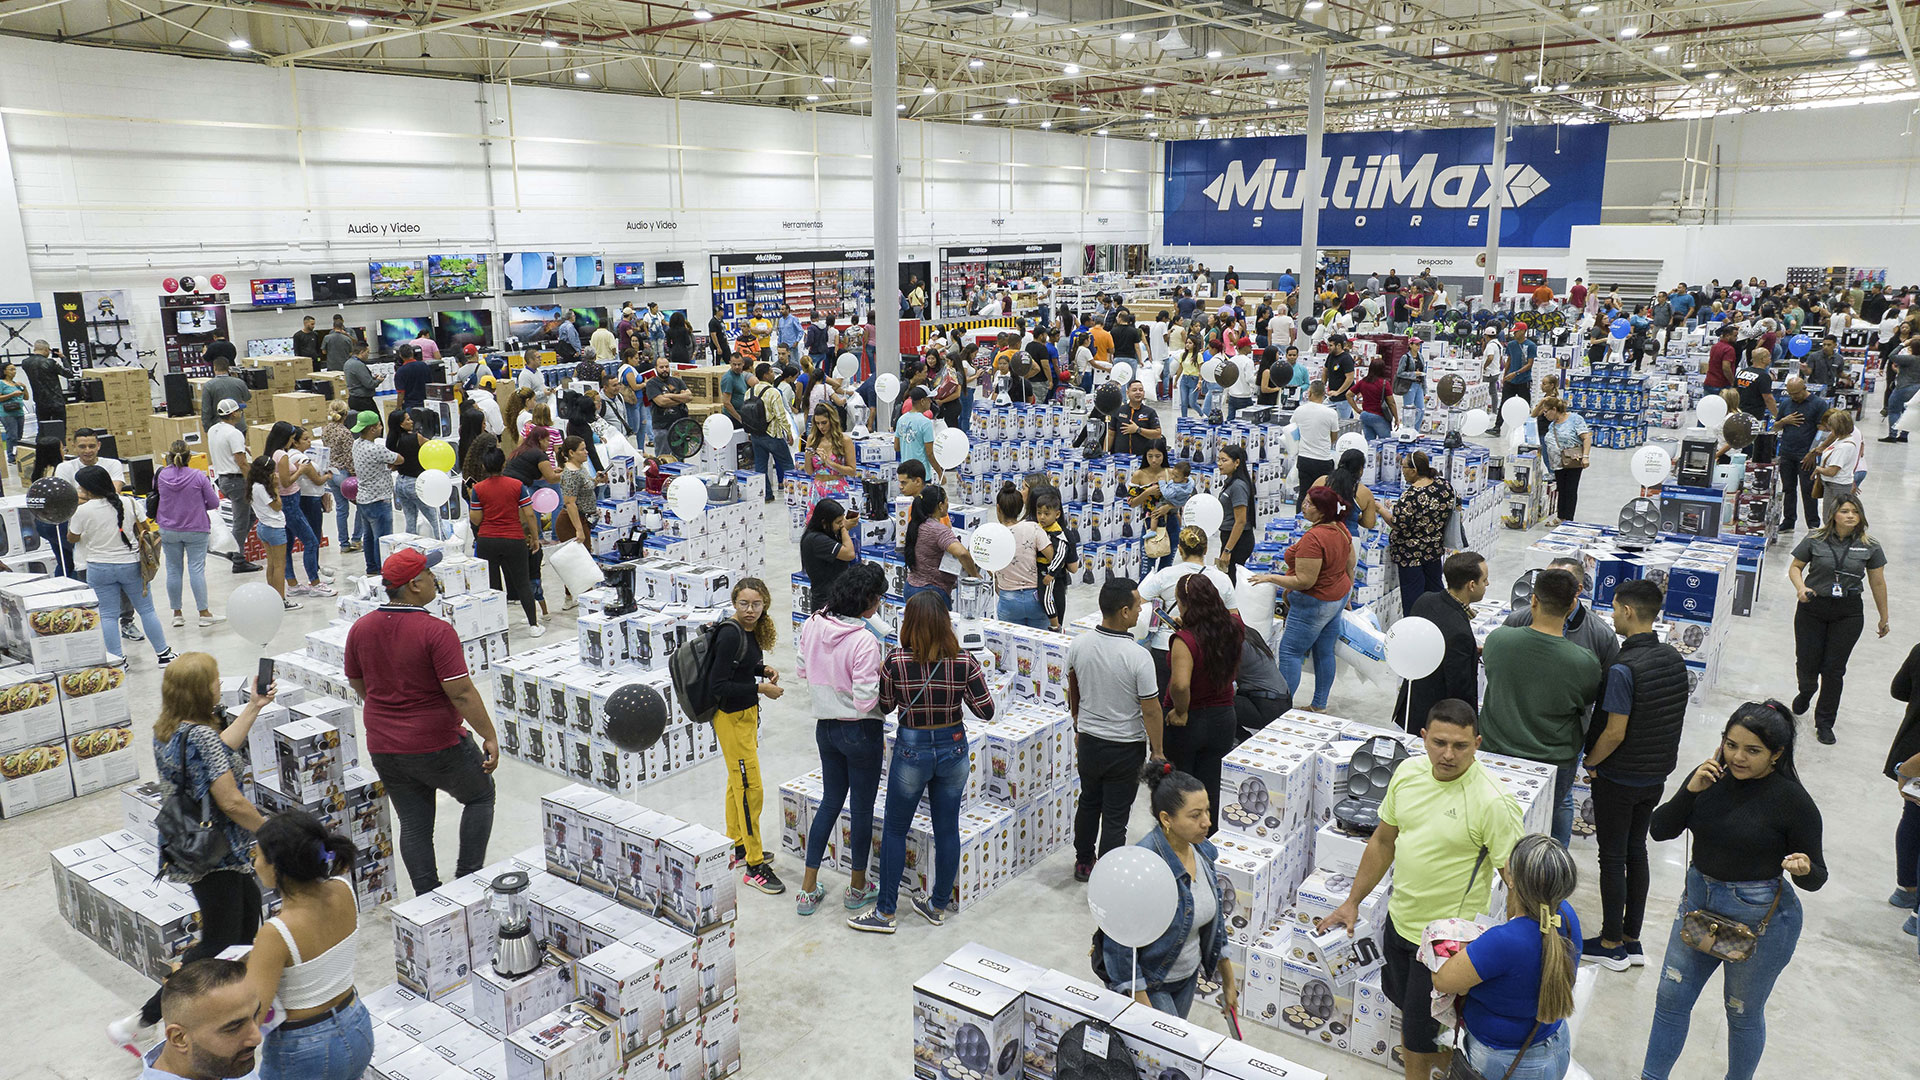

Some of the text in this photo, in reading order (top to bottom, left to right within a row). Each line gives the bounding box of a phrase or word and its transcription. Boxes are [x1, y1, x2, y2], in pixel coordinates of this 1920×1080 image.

[1218, 154, 1526, 211] MultiMax
[627, 220, 677, 232] Audio y Video
[782, 220, 824, 229] Herramientas
[1253, 215, 1481, 228] SORE
[348, 222, 421, 236] Audio y Video
[1417, 258, 1454, 267] Despacho
[705, 851, 726, 863] KUCCE
[1299, 891, 1327, 902] DAEWOO
[707, 930, 726, 944] KUCCE
[669, 951, 689, 965] KUCCE
[1284, 961, 1308, 973] DAEWOO
[630, 972, 650, 987] KUCCE
[1067, 986, 1097, 1001] KUCCE
[711, 1006, 730, 1022] KUCCE
[918, 1001, 940, 1013] KUCCE
[1029, 1007, 1053, 1020] KUCCE
[673, 1029, 693, 1044] KUCCE
[1154, 1022, 1187, 1037] KUCCE
[634, 1051, 654, 1067] KUCCE
[1250, 1060, 1286, 1076] KUCCE
